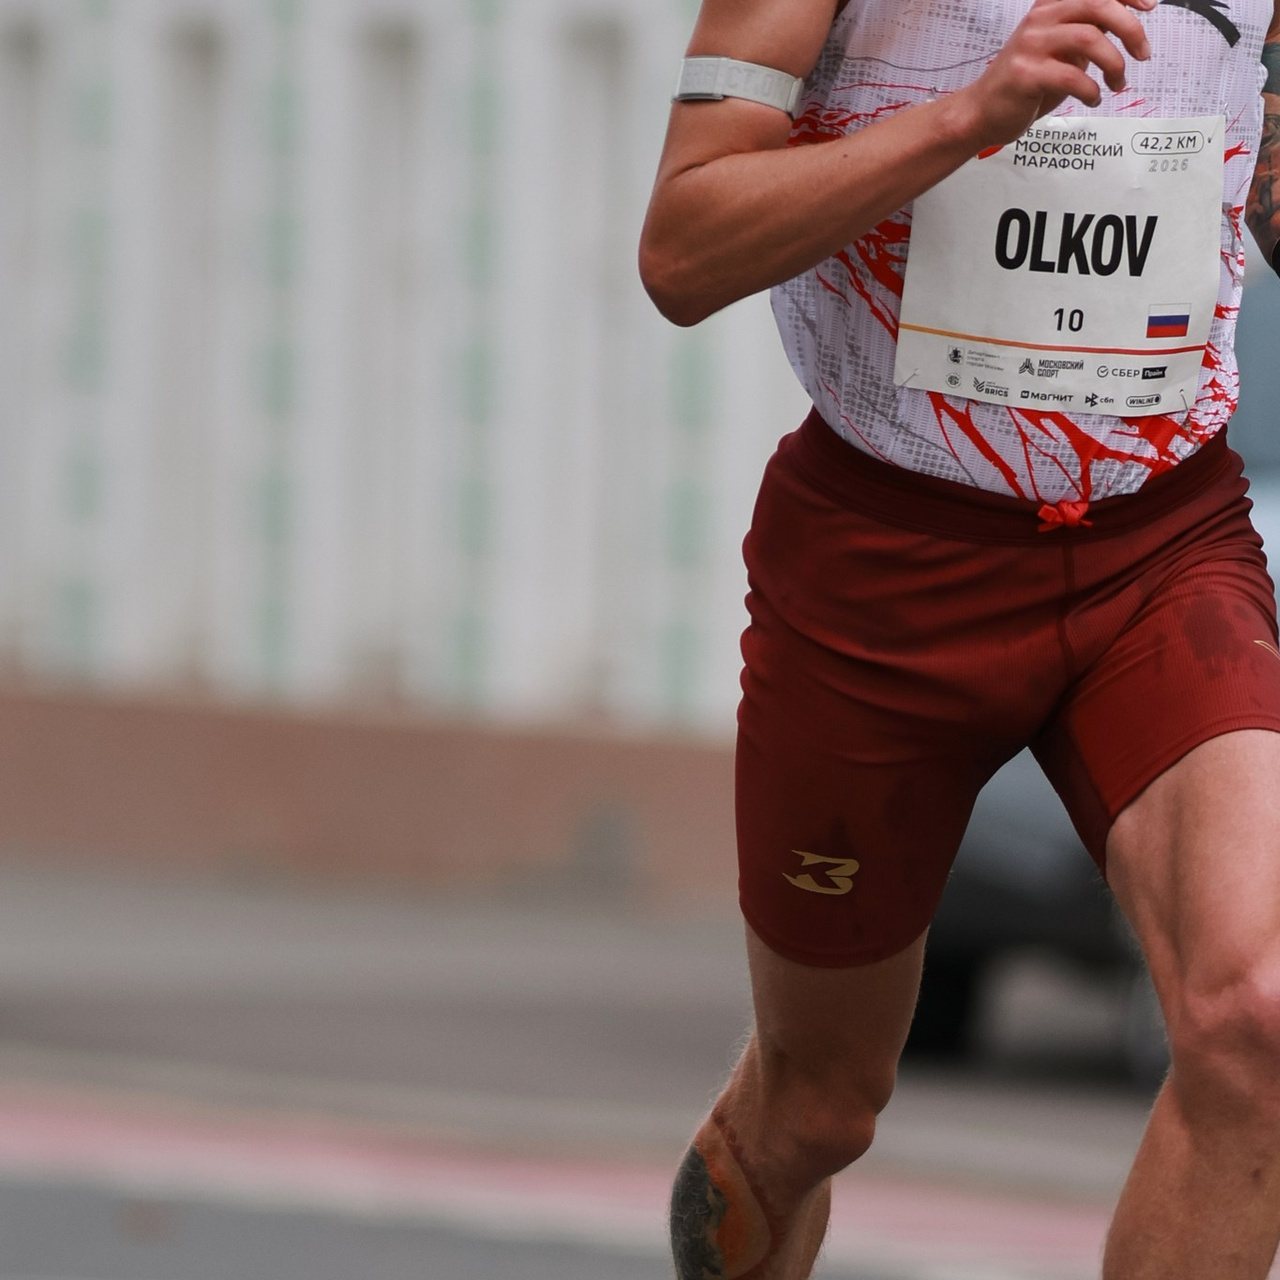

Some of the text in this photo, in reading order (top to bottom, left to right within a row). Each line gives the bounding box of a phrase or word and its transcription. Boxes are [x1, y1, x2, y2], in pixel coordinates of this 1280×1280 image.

[1022, 128, 1098, 141] БЕРПРАЙМ
[1015, 139, 1124, 157] МОСКОВСКИЙ
[1139, 136, 1173, 151] 42,2
[1013, 154, 1096, 171] МАРАФОН
[994, 207, 1158, 277] OLKOV
[1053, 307, 1085, 333] 10
[1037, 358, 1084, 371] МОСКОВСКИЙ
[1036, 368, 1060, 379] СПОРТ
[1111, 368, 1141, 378] СБЕР
[984, 387, 1009, 398] BRICS
